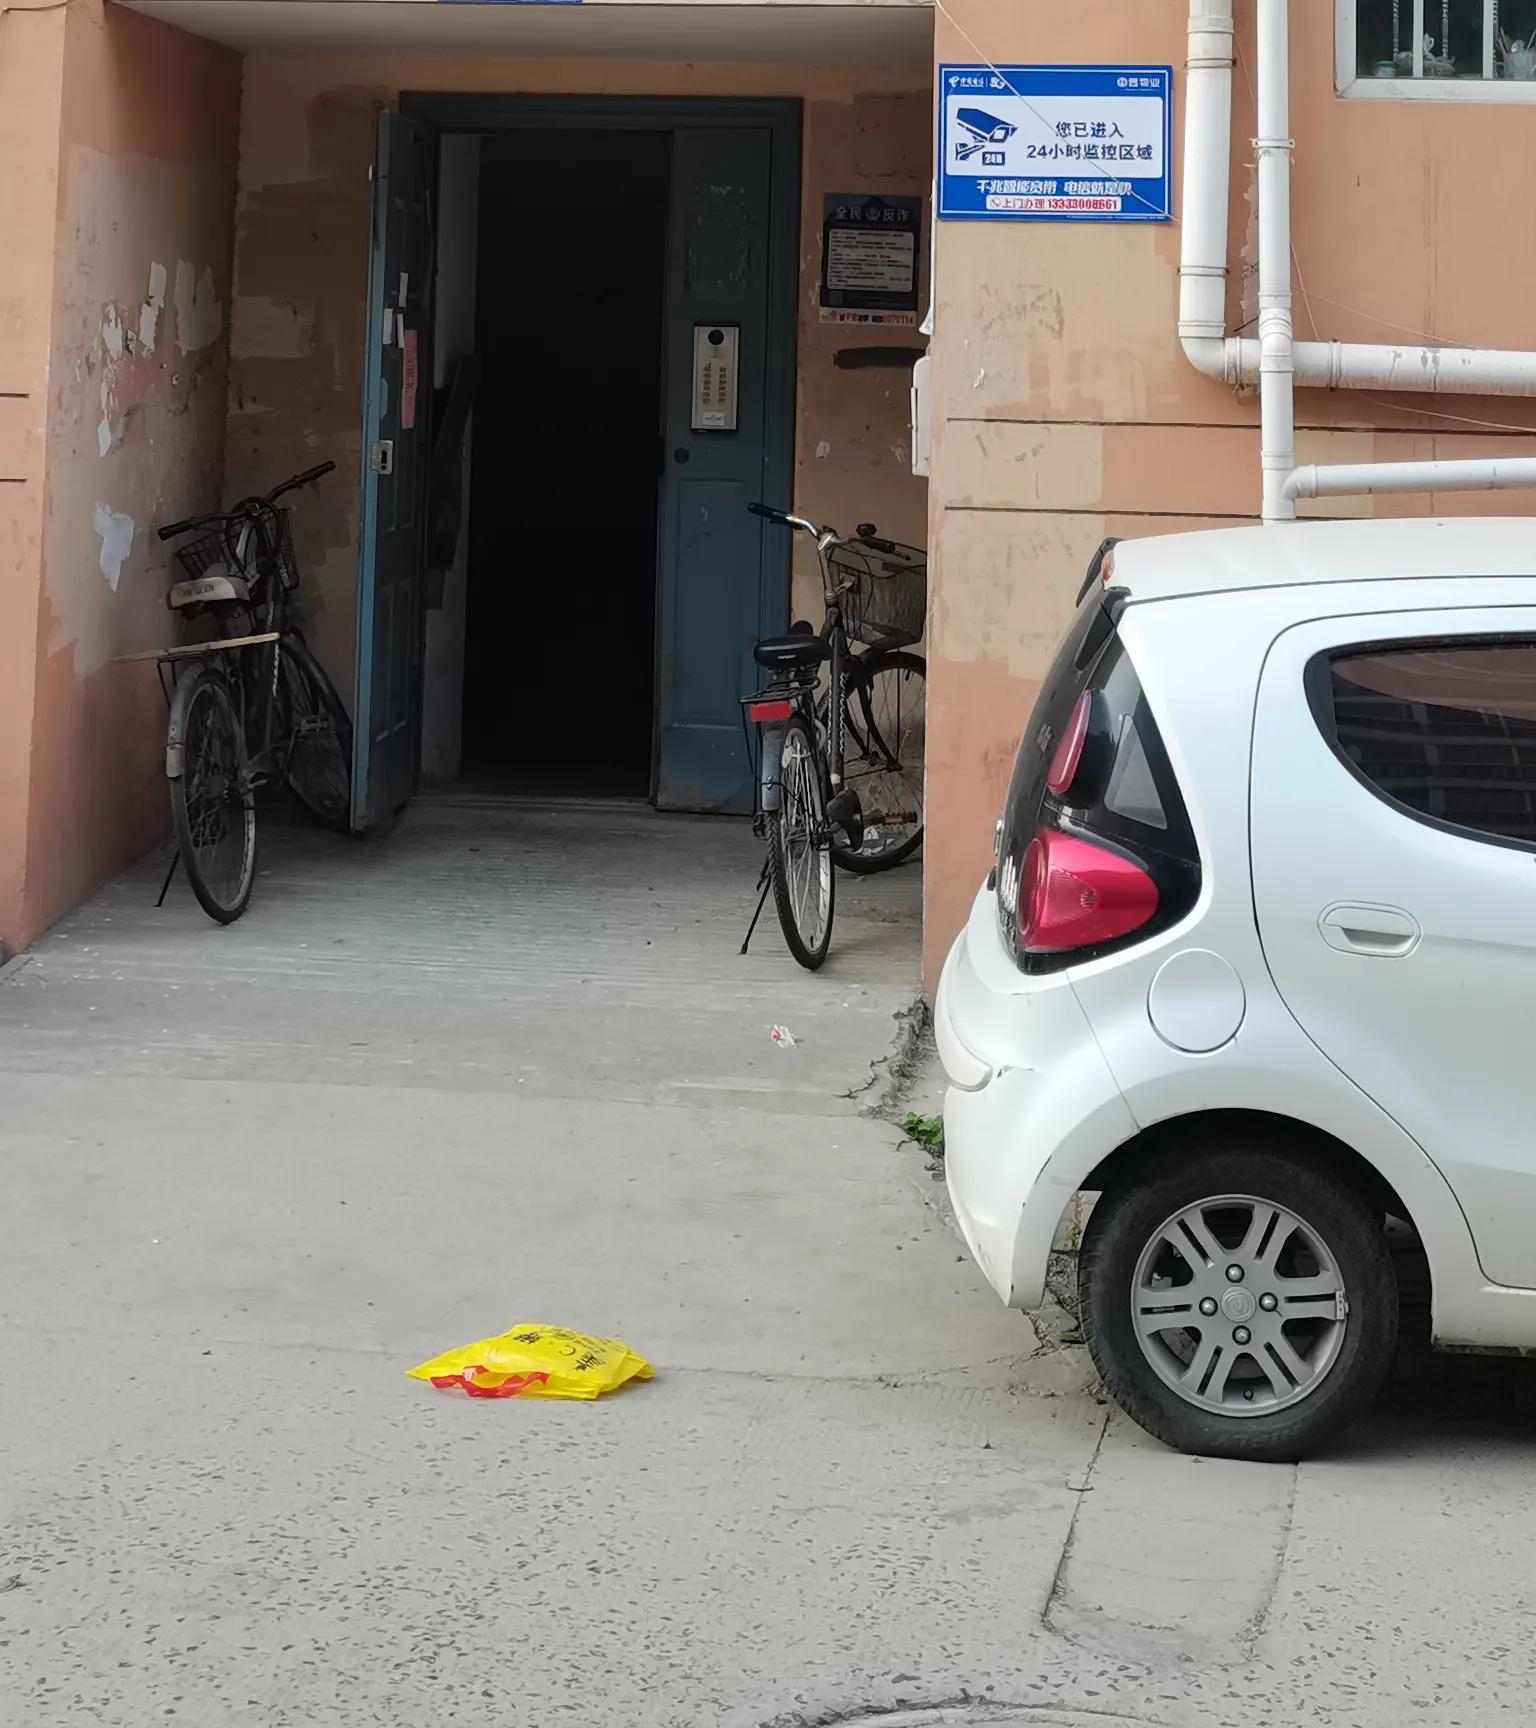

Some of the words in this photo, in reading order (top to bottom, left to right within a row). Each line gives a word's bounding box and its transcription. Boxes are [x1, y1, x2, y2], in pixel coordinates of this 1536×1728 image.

[1055, 121, 1125, 139] 您已进入
[1026, 144, 1154, 161] 24小时监控区域
